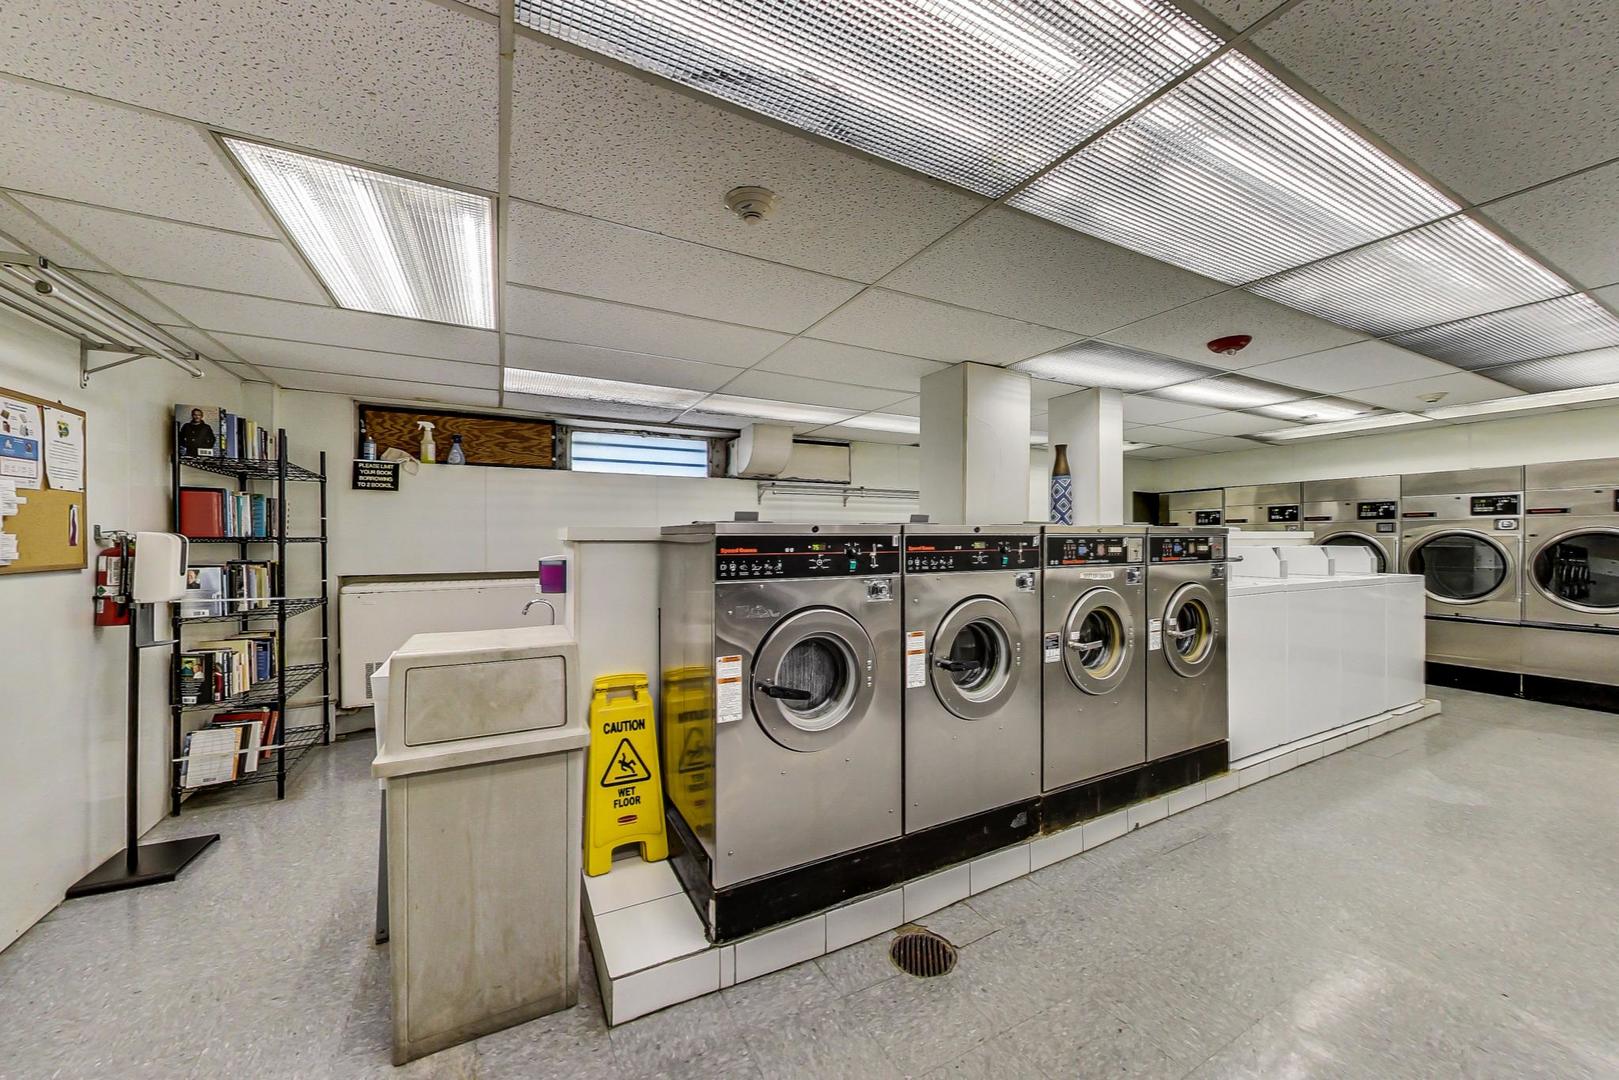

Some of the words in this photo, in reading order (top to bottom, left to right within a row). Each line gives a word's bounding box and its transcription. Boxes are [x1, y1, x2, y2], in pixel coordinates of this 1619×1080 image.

[603, 719, 645, 734] CAUTION
[618, 786, 636, 797] WET
[613, 796, 641, 808] FLOOR
